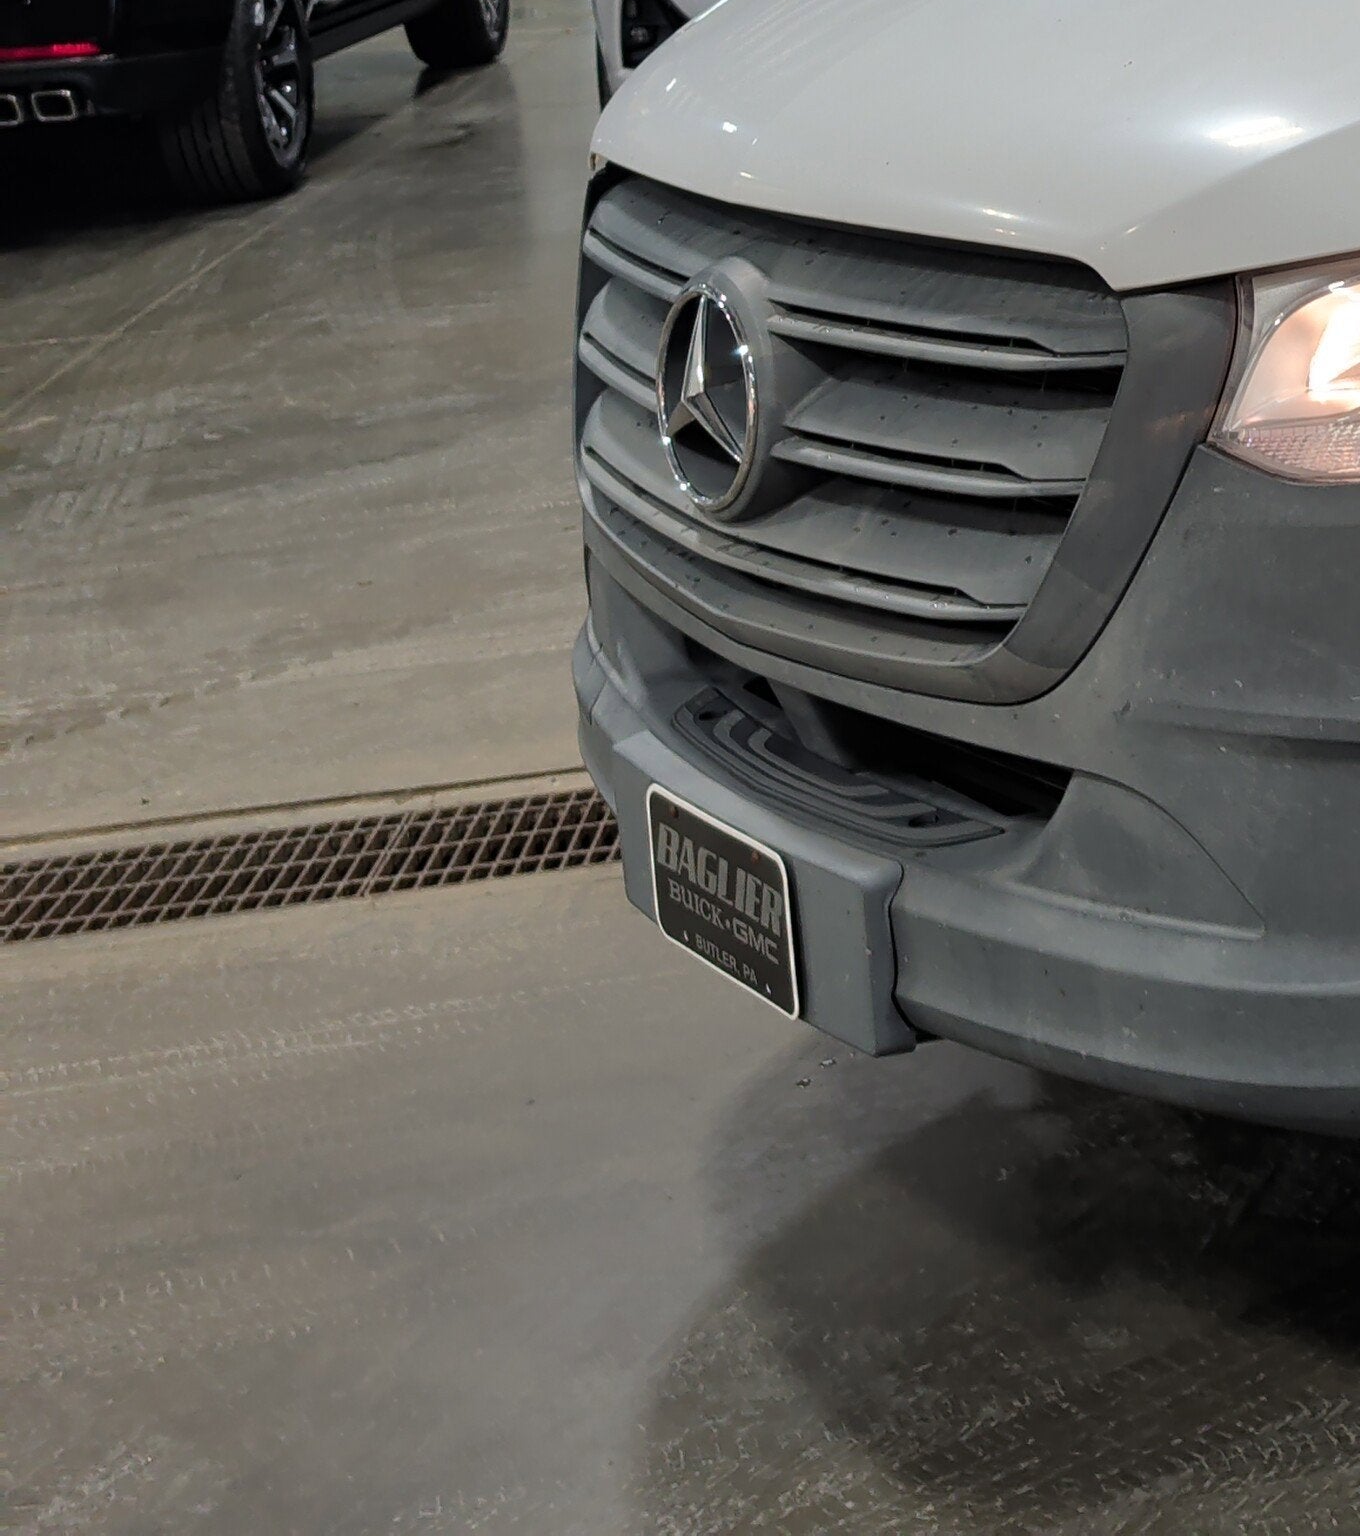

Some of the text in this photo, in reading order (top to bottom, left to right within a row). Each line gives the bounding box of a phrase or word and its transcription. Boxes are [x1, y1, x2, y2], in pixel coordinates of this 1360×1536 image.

[656, 822, 783, 938] BAGLIER
[667, 877, 779, 964] BUICK GMC
[742, 964, 758, 984] PA
